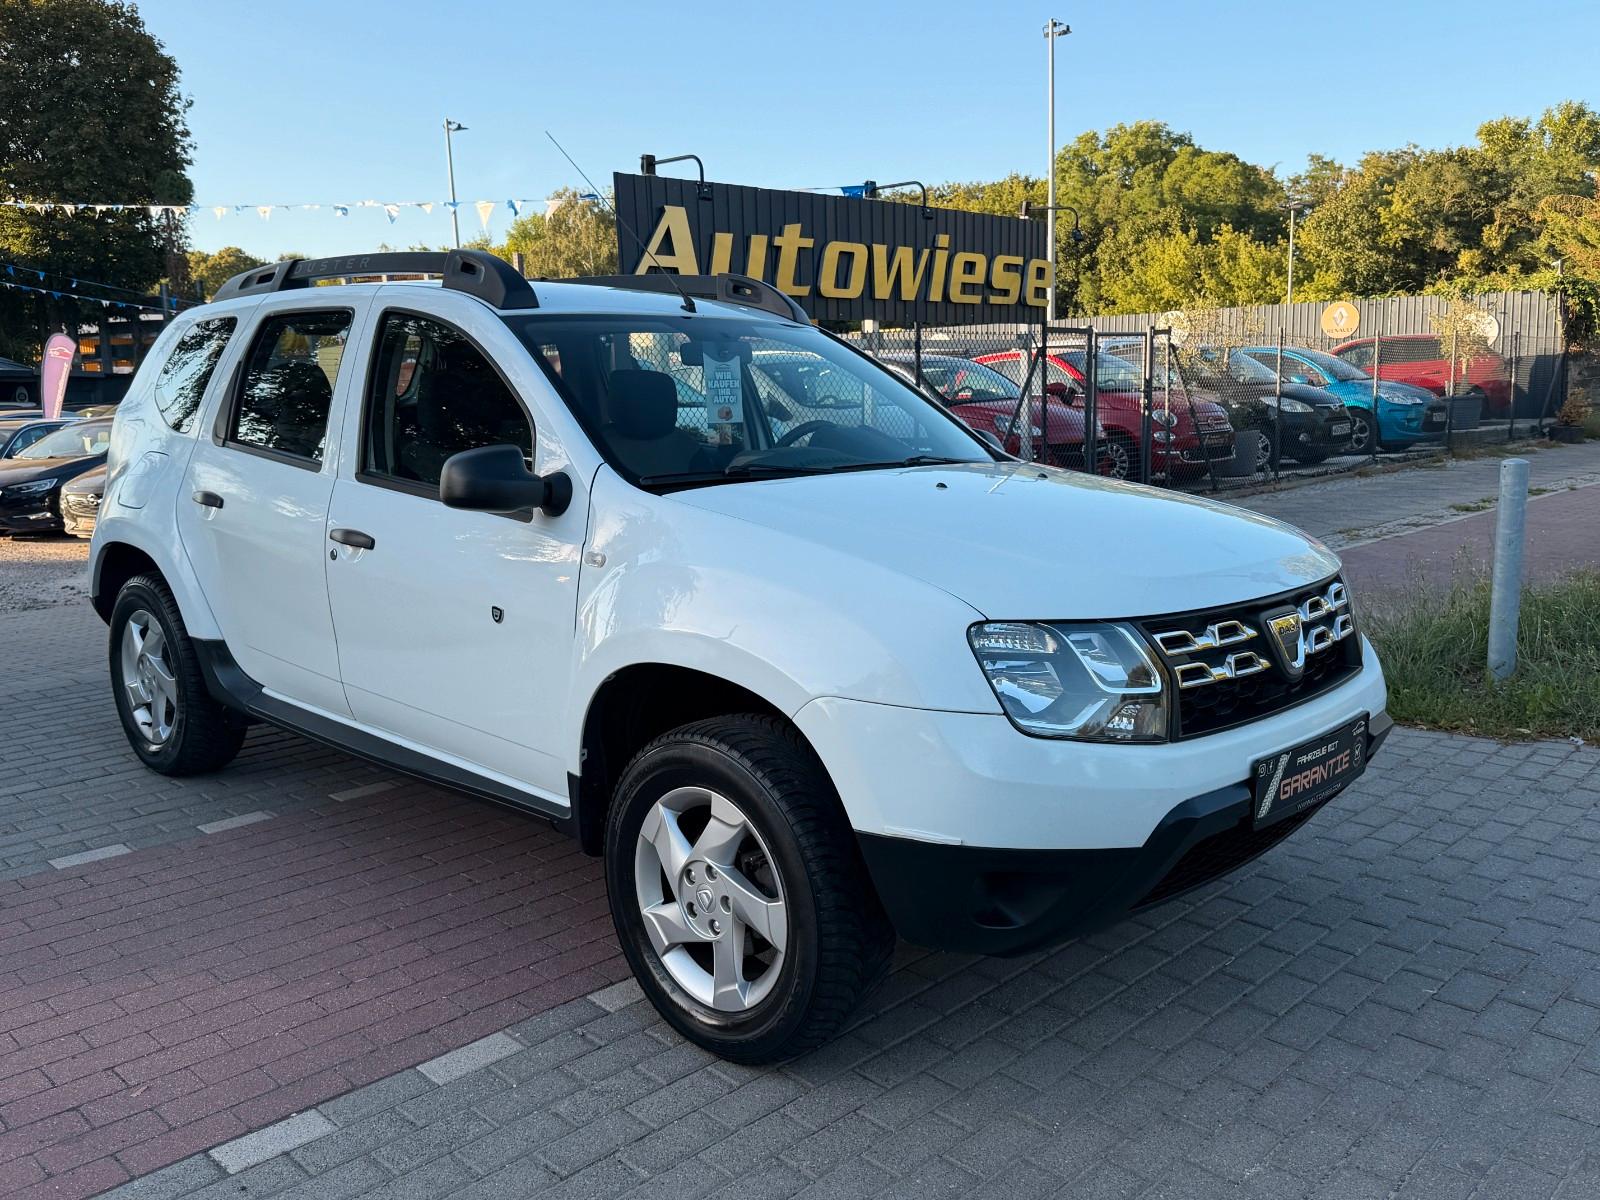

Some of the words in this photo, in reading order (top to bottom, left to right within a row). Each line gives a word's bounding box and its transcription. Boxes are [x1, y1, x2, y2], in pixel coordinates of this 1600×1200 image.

[635, 205, 1055, 308] Autowiese
[294, 257, 370, 274] DUSTER
[714, 371, 732, 380] WIR
[708, 380, 740, 389] KAUFEN
[718, 388, 731, 396] IHR
[713, 395, 737, 404] AUTO!
[1279, 749, 1351, 801] GARANTIE
